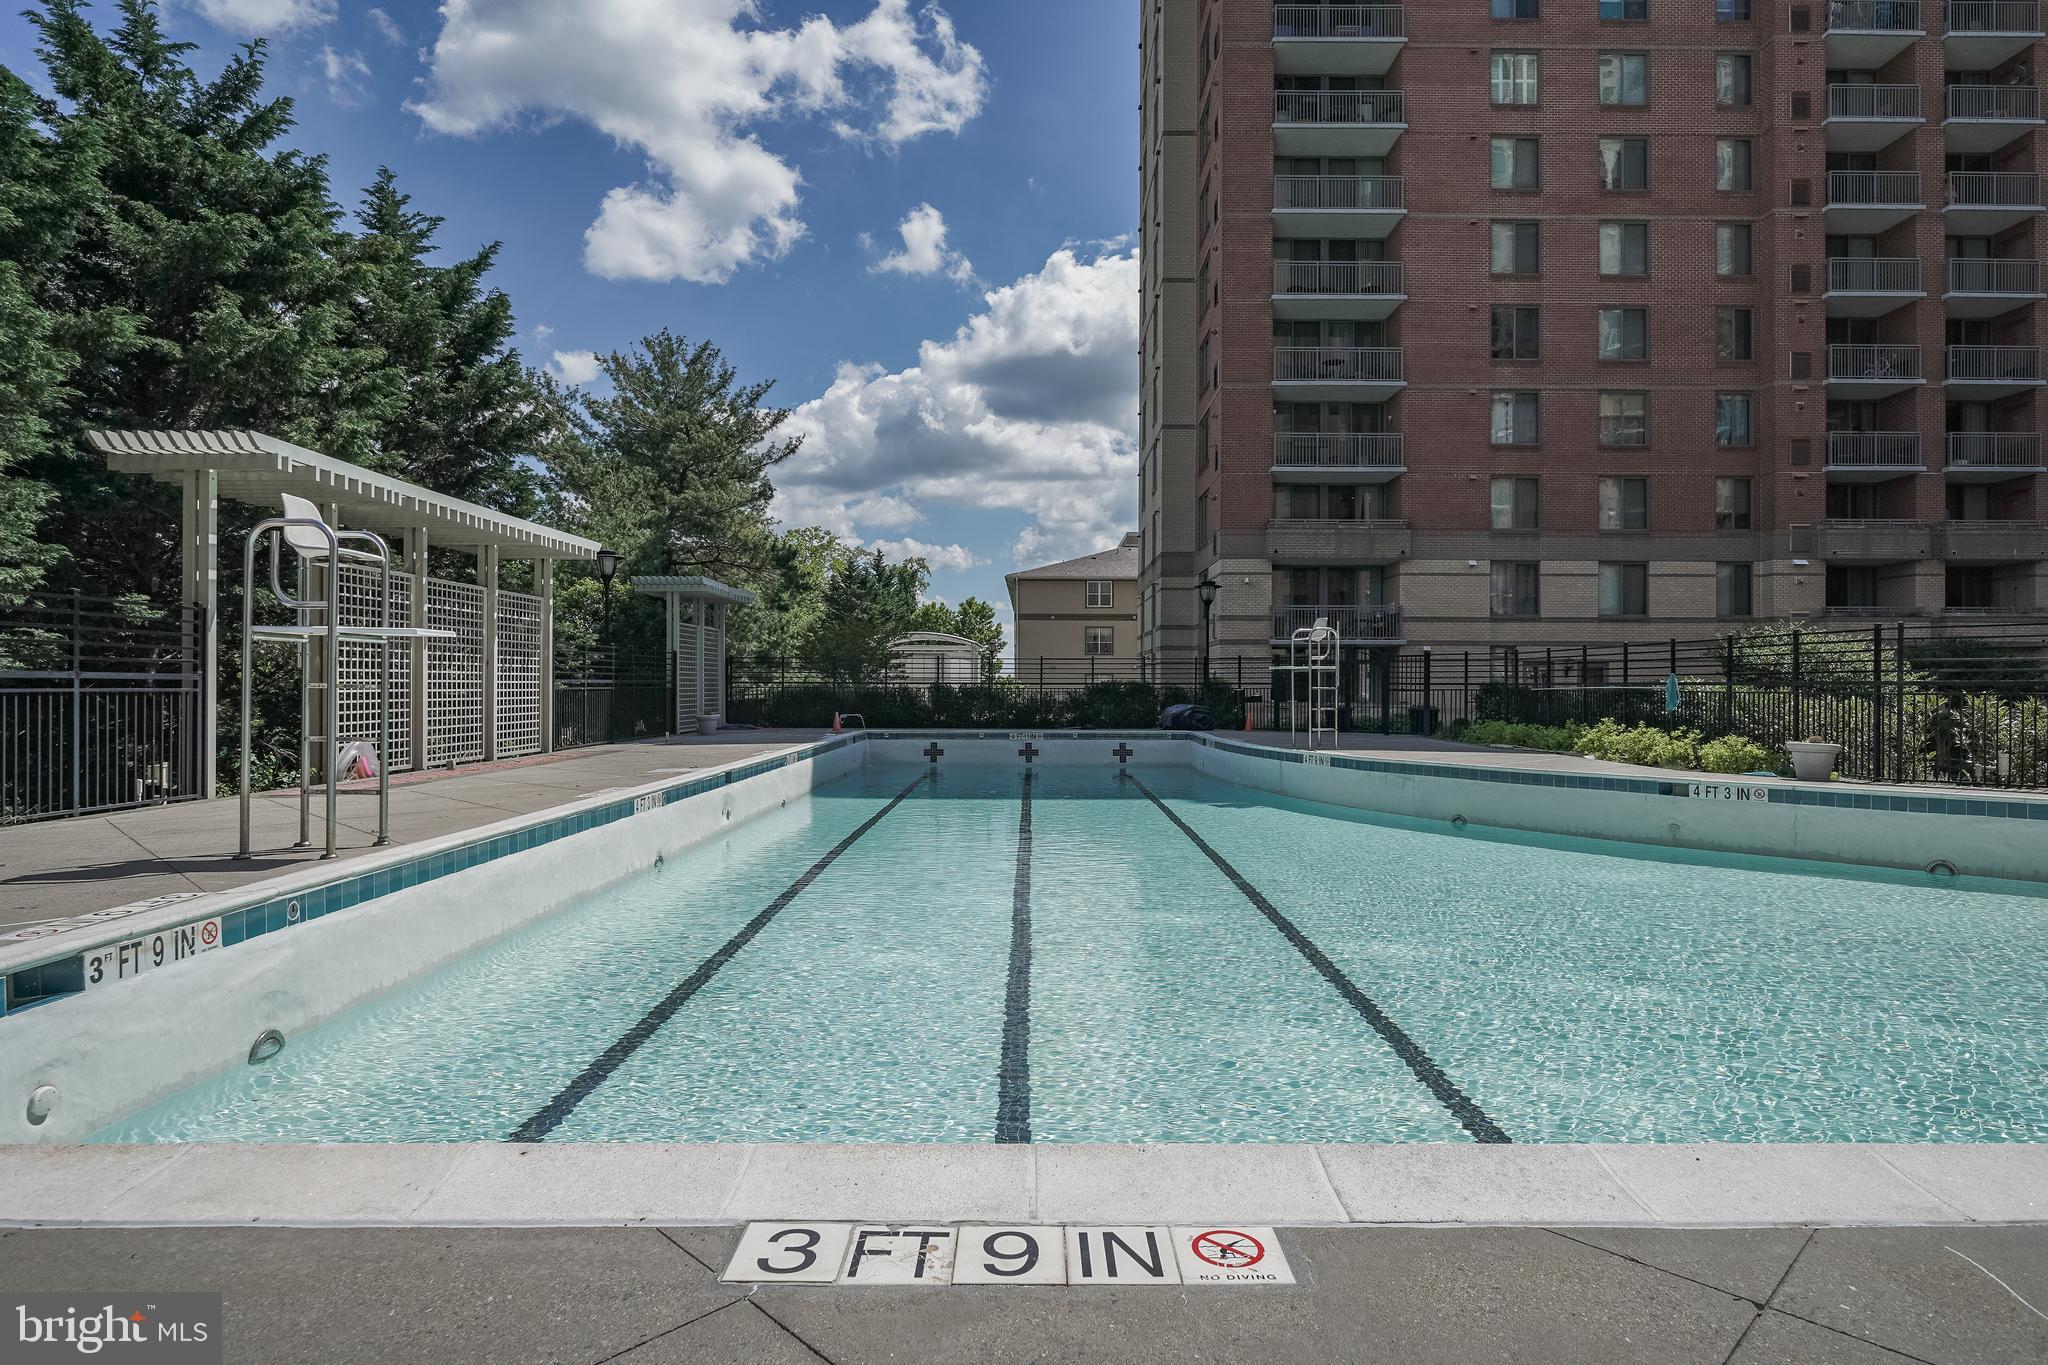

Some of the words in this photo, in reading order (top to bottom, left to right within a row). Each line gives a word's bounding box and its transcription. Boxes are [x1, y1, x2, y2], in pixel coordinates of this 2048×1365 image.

[1694, 786, 1700, 797] 4
[1705, 786, 1718, 798] FT
[1724, 787, 1731, 799] 3
[1737, 788, 1749, 800] IN
[90, 956, 104, 984] 3
[119, 941, 143, 978] FT
[153, 935, 164, 967] 9
[174, 926, 195, 960] IN
[756, 1228, 821, 1274] 3
[845, 1230, 951, 1278] FT
[982, 1231, 1040, 1277] 9
[1080, 1231, 1165, 1278] IN
